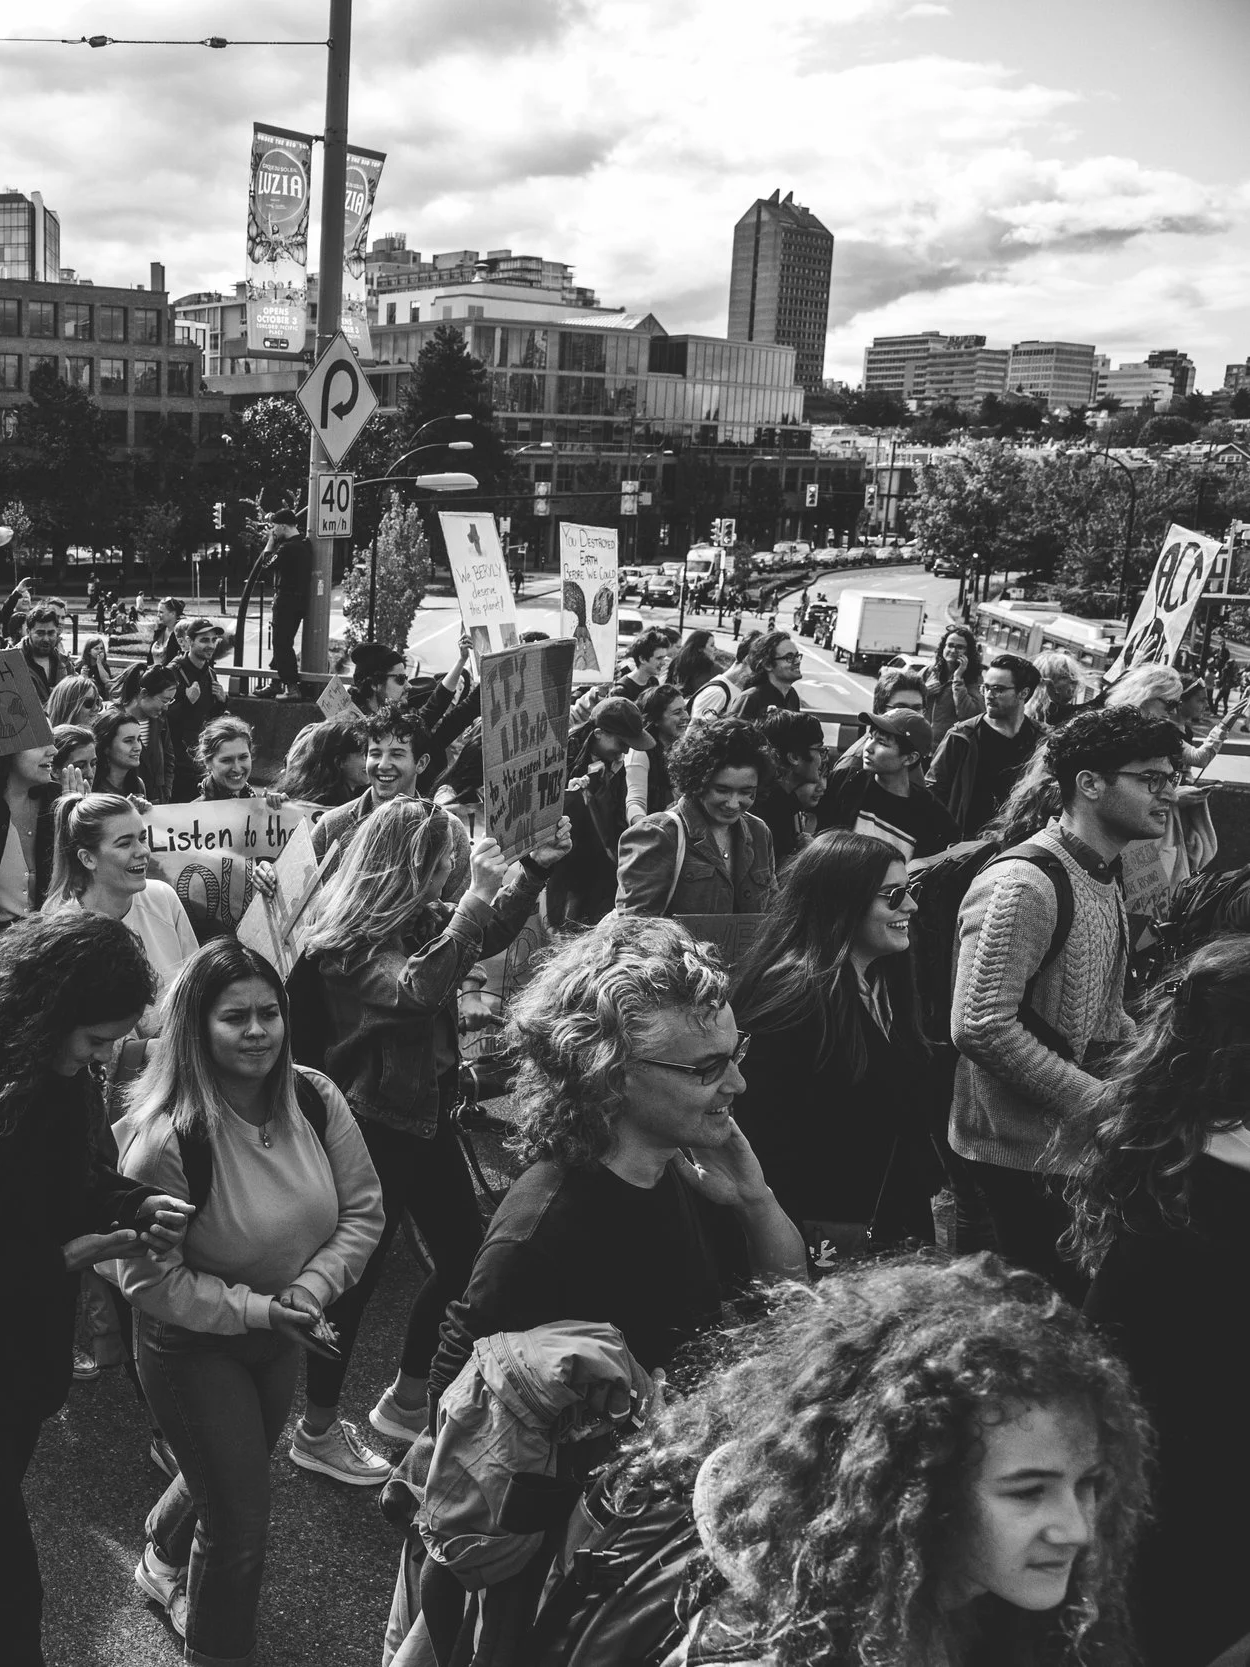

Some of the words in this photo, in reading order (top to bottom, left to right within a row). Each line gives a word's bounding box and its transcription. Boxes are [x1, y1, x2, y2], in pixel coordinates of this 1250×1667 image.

[258, 170, 302, 200] LUZIA
[345, 189, 366, 217] ZIA
[256, 315, 290, 325] OCTOBER
[292, 316, 299, 326] 3
[263, 307, 290, 317] OPENS
[321, 479, 350, 513] 40
[322, 516, 347, 531] km/h
[147, 819, 233, 853] Listen
[244, 814, 257, 848] to
